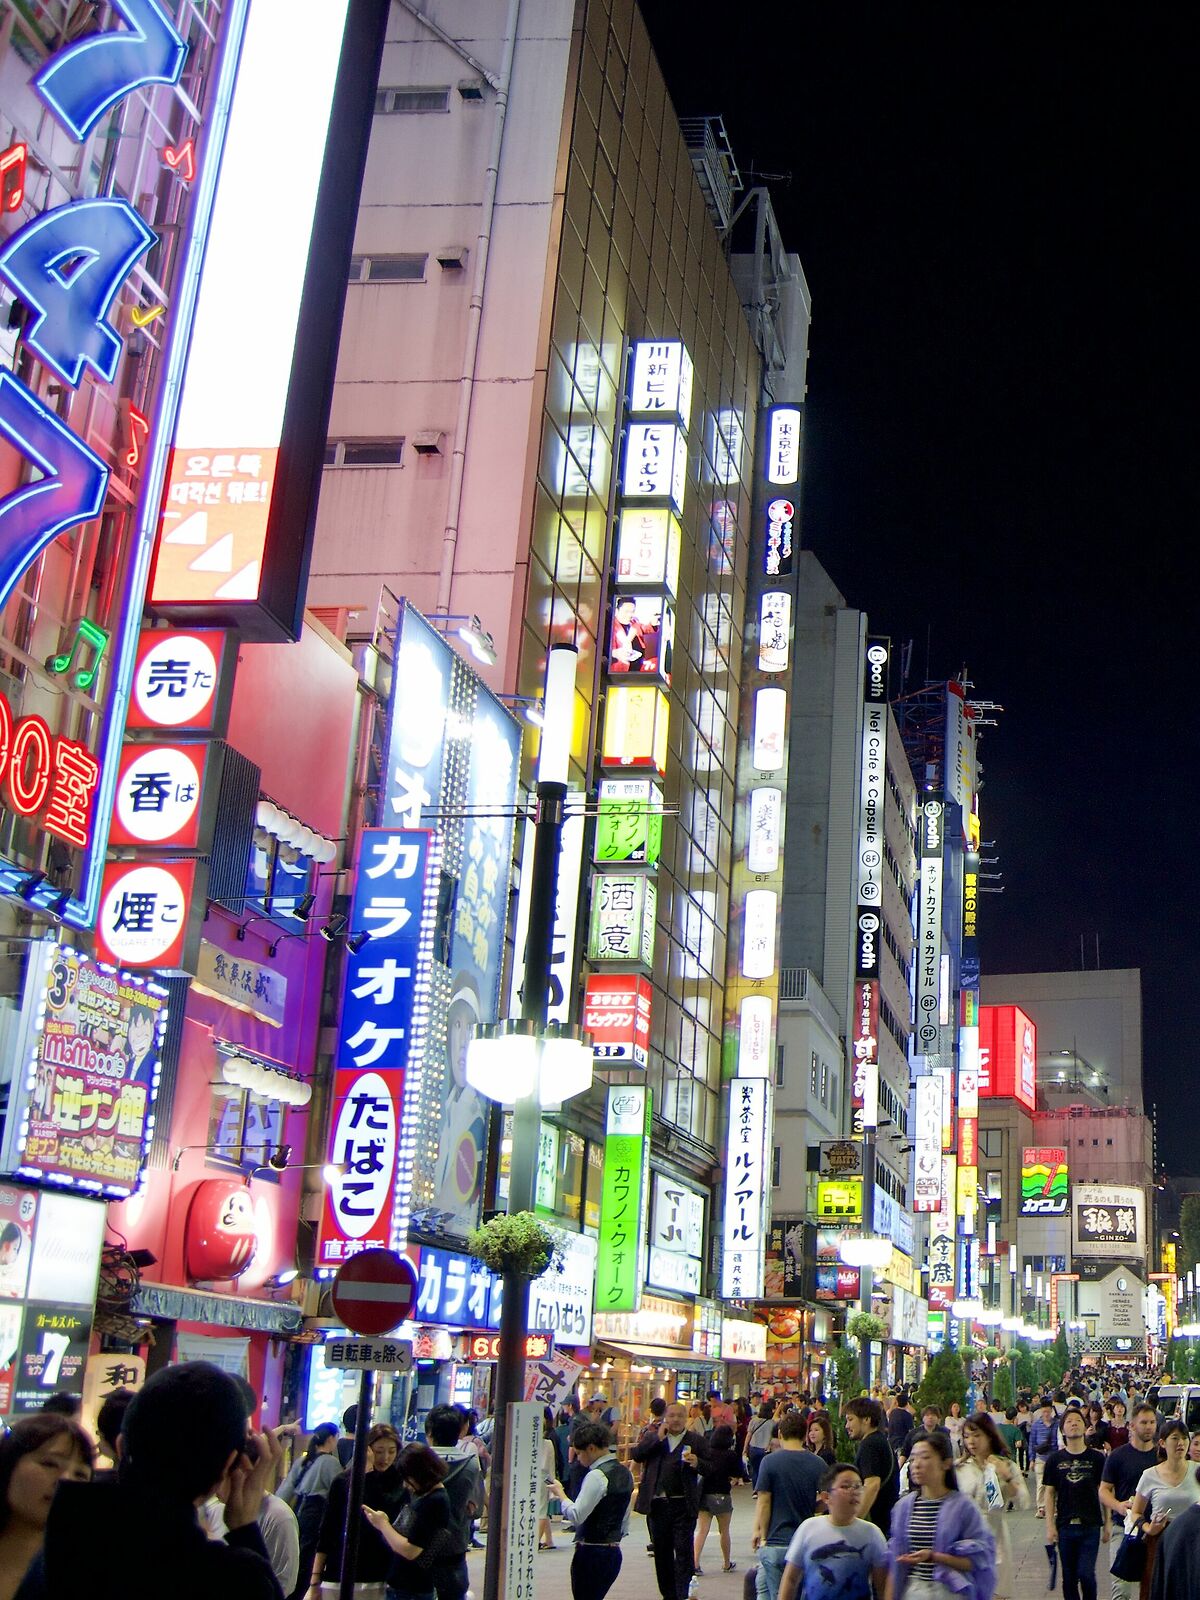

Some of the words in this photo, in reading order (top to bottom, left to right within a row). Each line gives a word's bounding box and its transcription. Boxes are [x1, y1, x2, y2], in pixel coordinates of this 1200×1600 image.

[644, 346, 669, 410] 川新ビル
[639, 426, 661, 493] にいむら
[776, 423, 791, 477] 東京ビル
[868, 645, 888, 698] Booth
[870, 710, 881, 733] Net
[868, 737, 881, 770] Cafe
[866, 788, 879, 843] Capsule
[924, 801, 943, 849] Booth
[926, 865, 937, 925] ネットカフェ
[346, 836, 421, 1067] カラオケ
[858, 912, 880, 969] Booth
[740, 1086, 754, 1144] 喫茶室
[339, 1093, 390, 1217] たばこ
[733, 1151, 754, 1242] ルノアール
[918, 1200, 937, 1212] B1
[1021, 1199, 1068, 1213] カワノ
[932, 1234, 955, 1284] 金の蔵
[535, 1298, 586, 1336] にいむら
[331, 1344, 404, 1364] 自転車を除く
